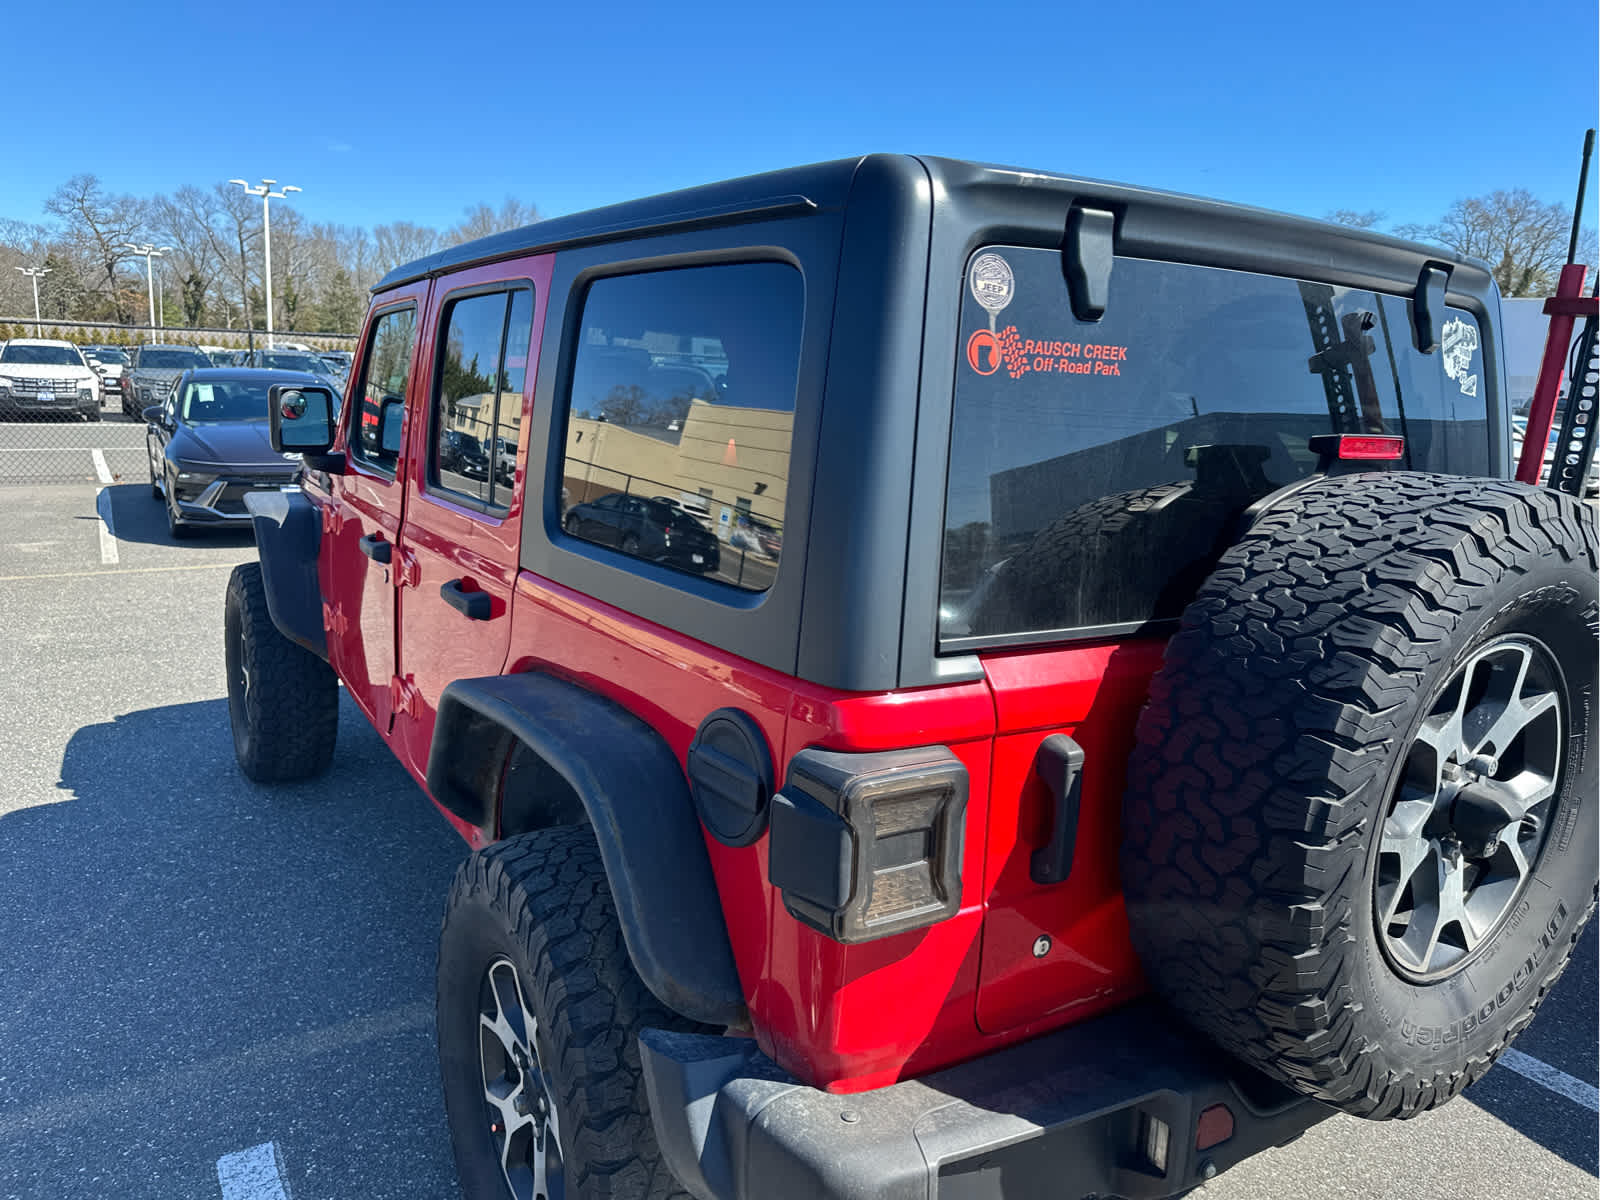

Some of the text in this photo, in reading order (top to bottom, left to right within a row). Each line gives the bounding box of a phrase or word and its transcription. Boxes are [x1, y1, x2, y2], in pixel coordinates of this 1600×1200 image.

[982, 282, 1004, 293] JEEP
[1024, 339, 1128, 361] RAUSCH CREEK
[1033, 358, 1121, 376] Off-Road Park
